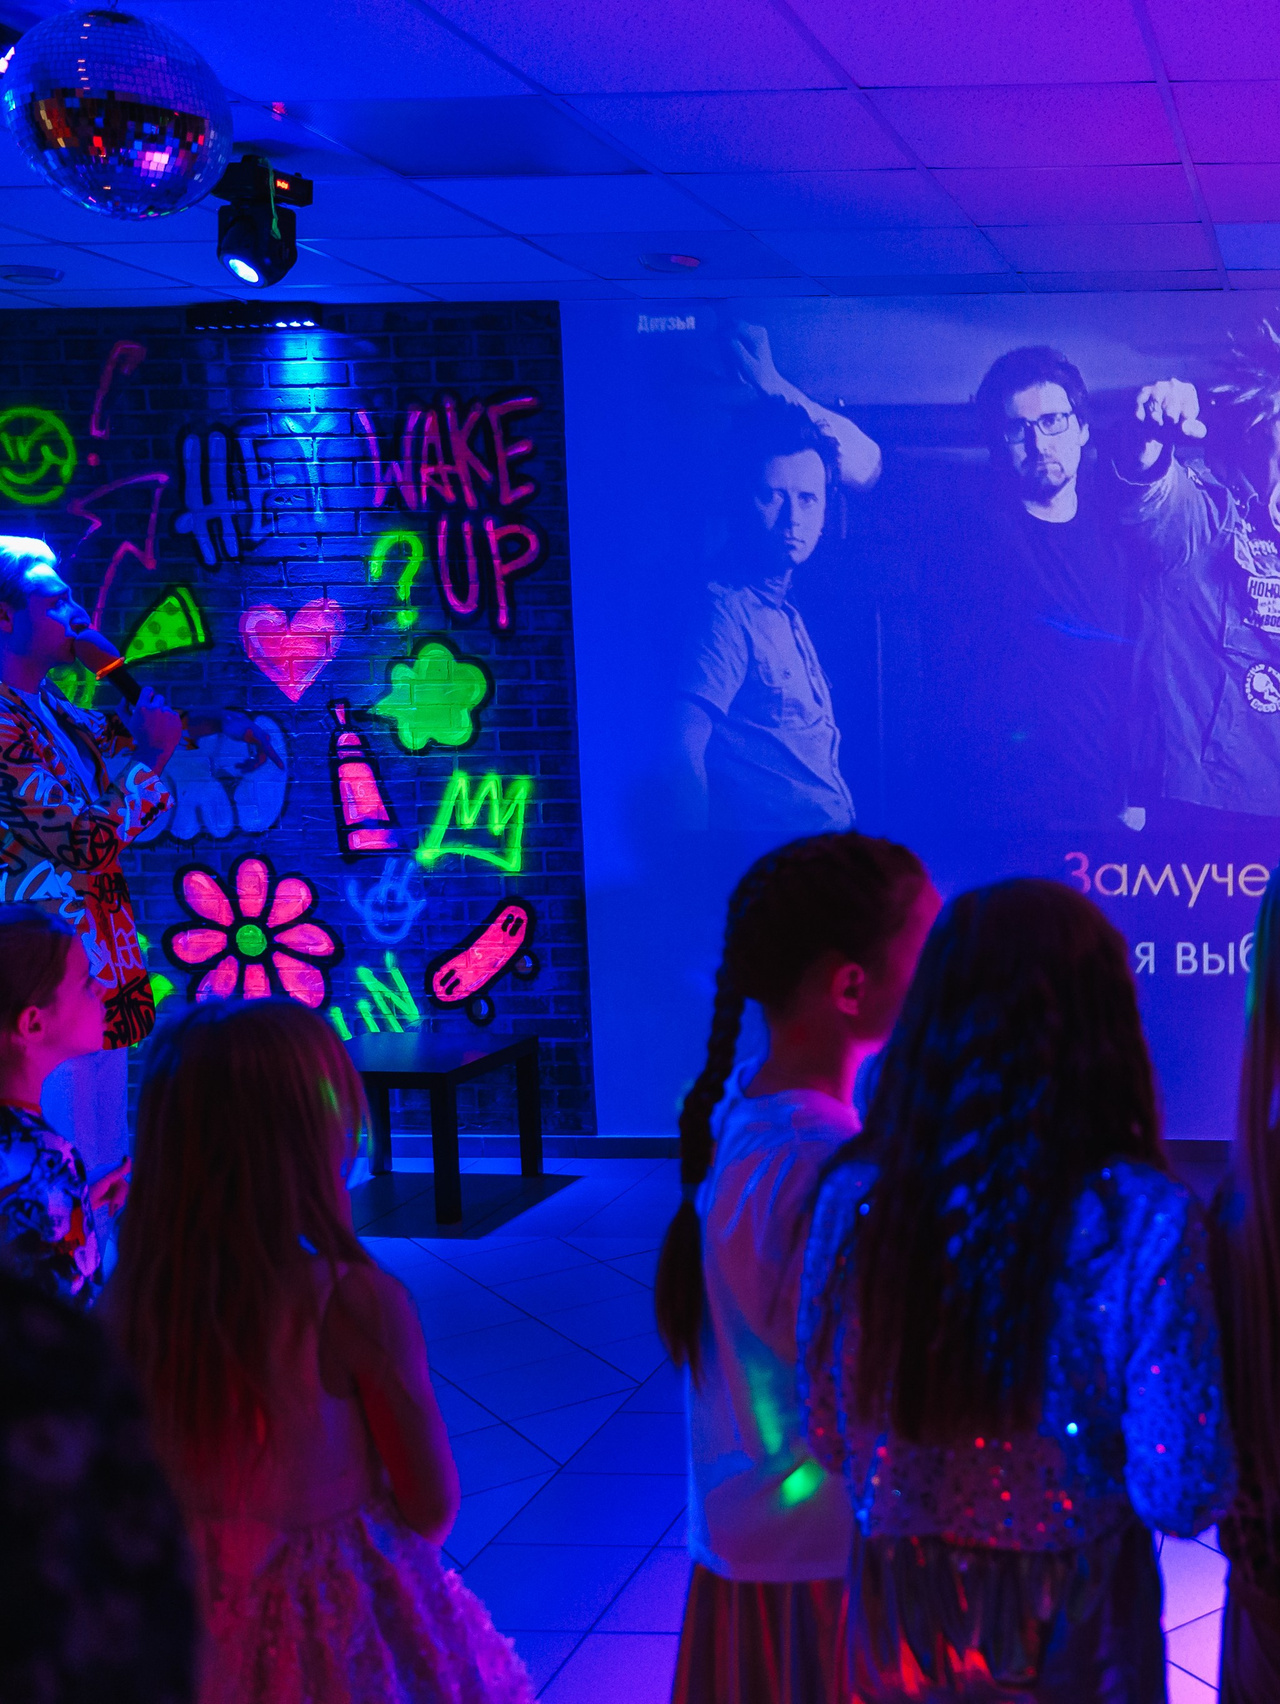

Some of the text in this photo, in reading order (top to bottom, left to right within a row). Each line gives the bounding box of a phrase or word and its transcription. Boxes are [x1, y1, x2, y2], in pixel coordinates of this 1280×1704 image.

[637, 314, 696, 333] Друзья
[174, 412, 338, 565] HEY
[357, 396, 538, 509] WAKE
[437, 514, 539, 628] UP
[1065, 852, 1270, 908] Замуче
